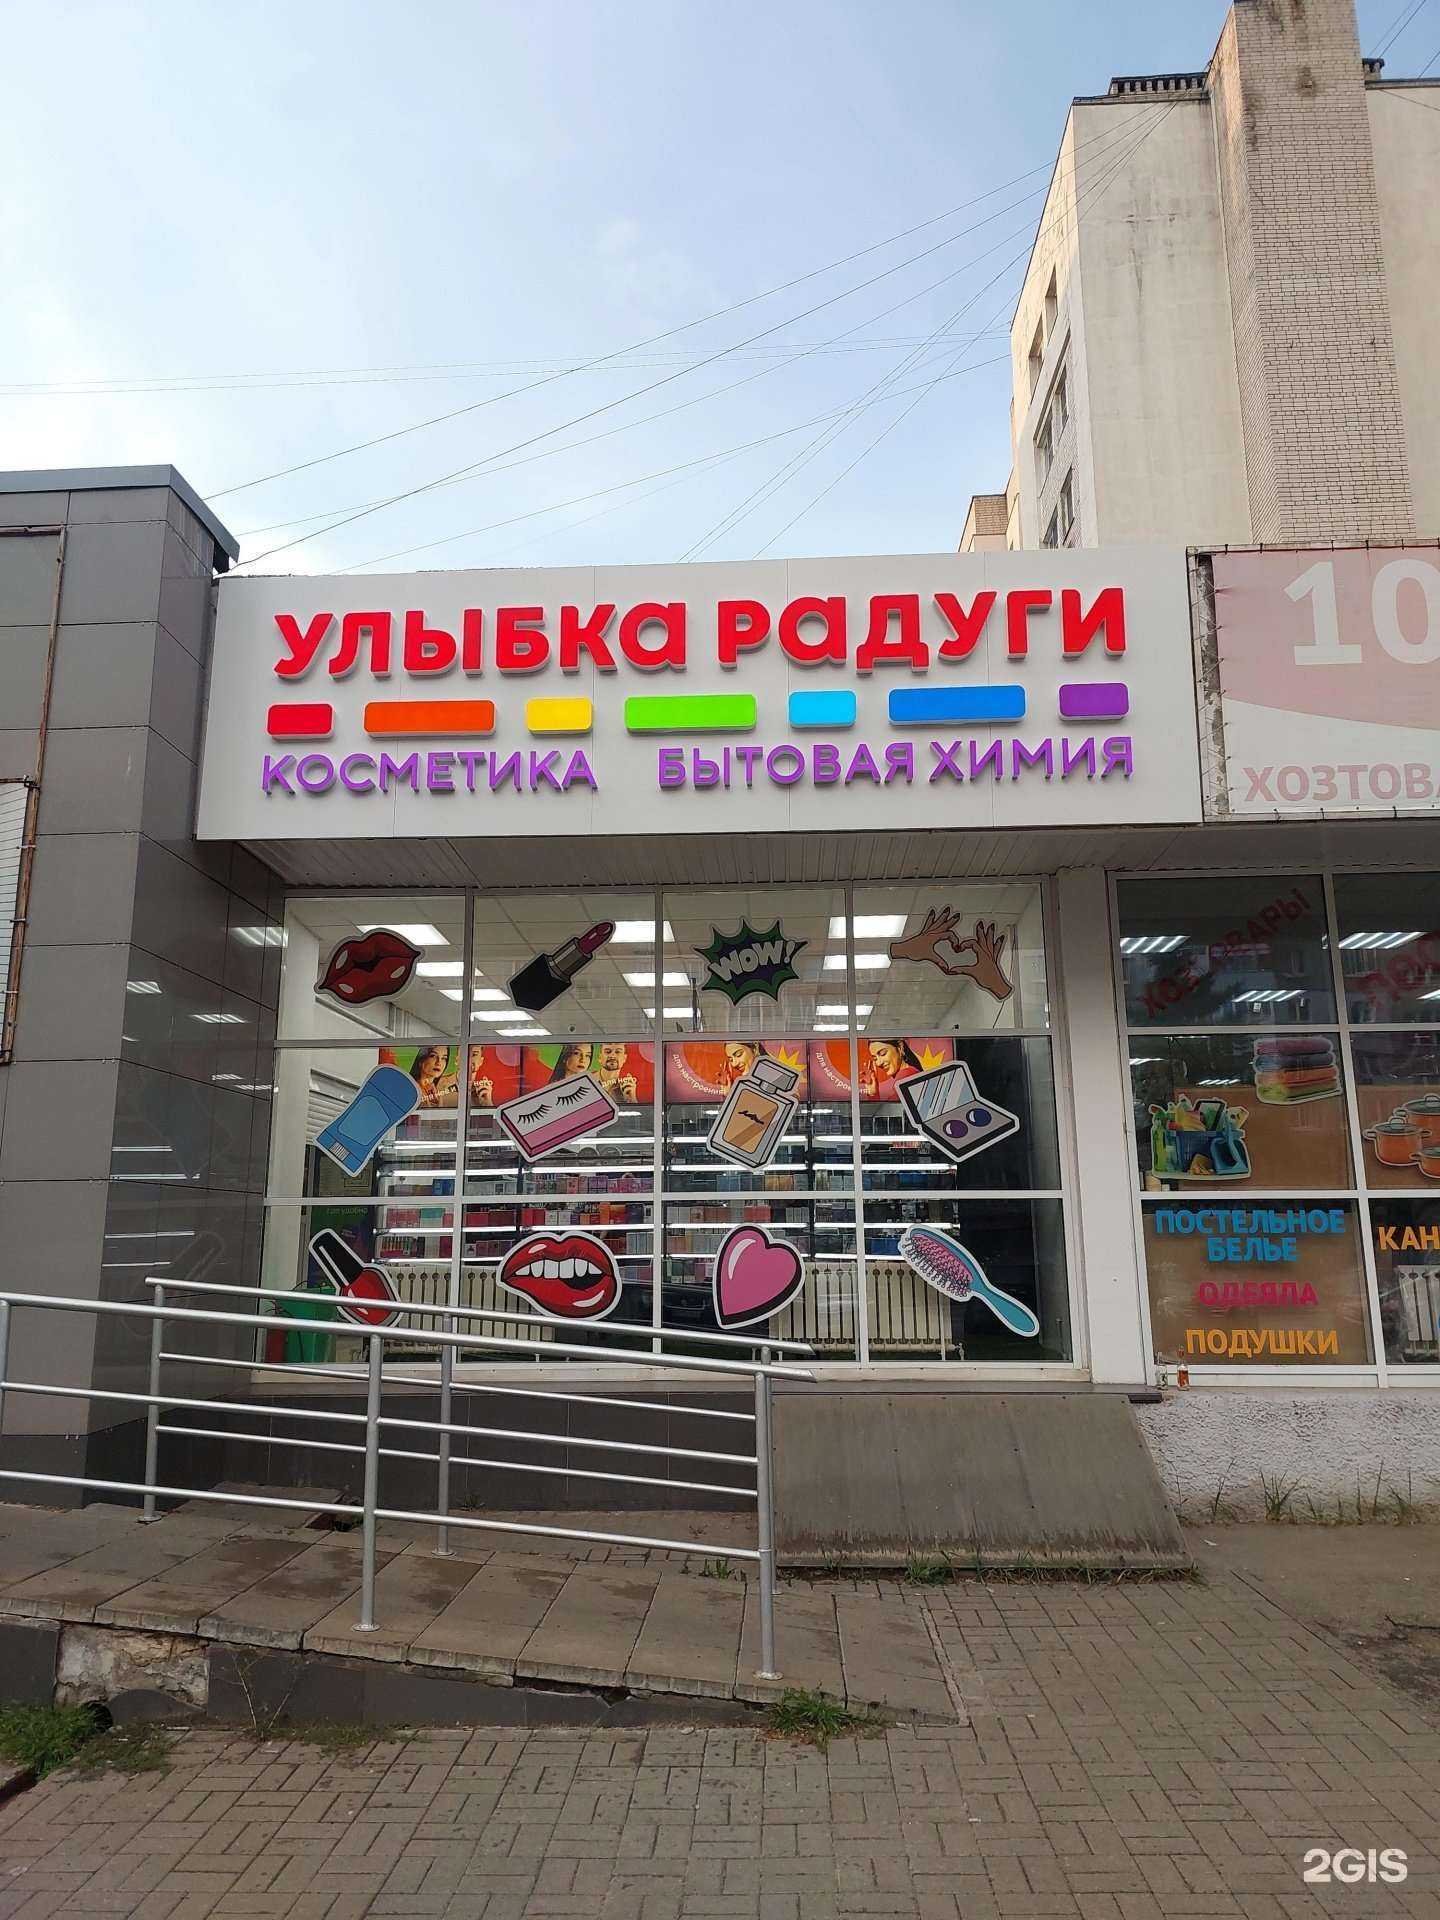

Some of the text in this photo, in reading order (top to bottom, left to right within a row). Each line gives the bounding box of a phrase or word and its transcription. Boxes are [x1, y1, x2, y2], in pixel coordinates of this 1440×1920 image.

[262, 736, 1134, 796] КОСМЕТИКА БЫТОВАЯ ХИМИЯ
[1242, 763, 1440, 802] ХОЗТОВ
[708, 940, 796, 982] WOW!
[1155, 1209, 1346, 1234] ПОСТЕЛЬНОЕ
[1208, 1236, 1299, 1262] БЕЛЬЕ
[1199, 1281, 1319, 1307] ОДЕЯЛА
[1185, 1328, 1339, 1358] ПОДУШКИ
